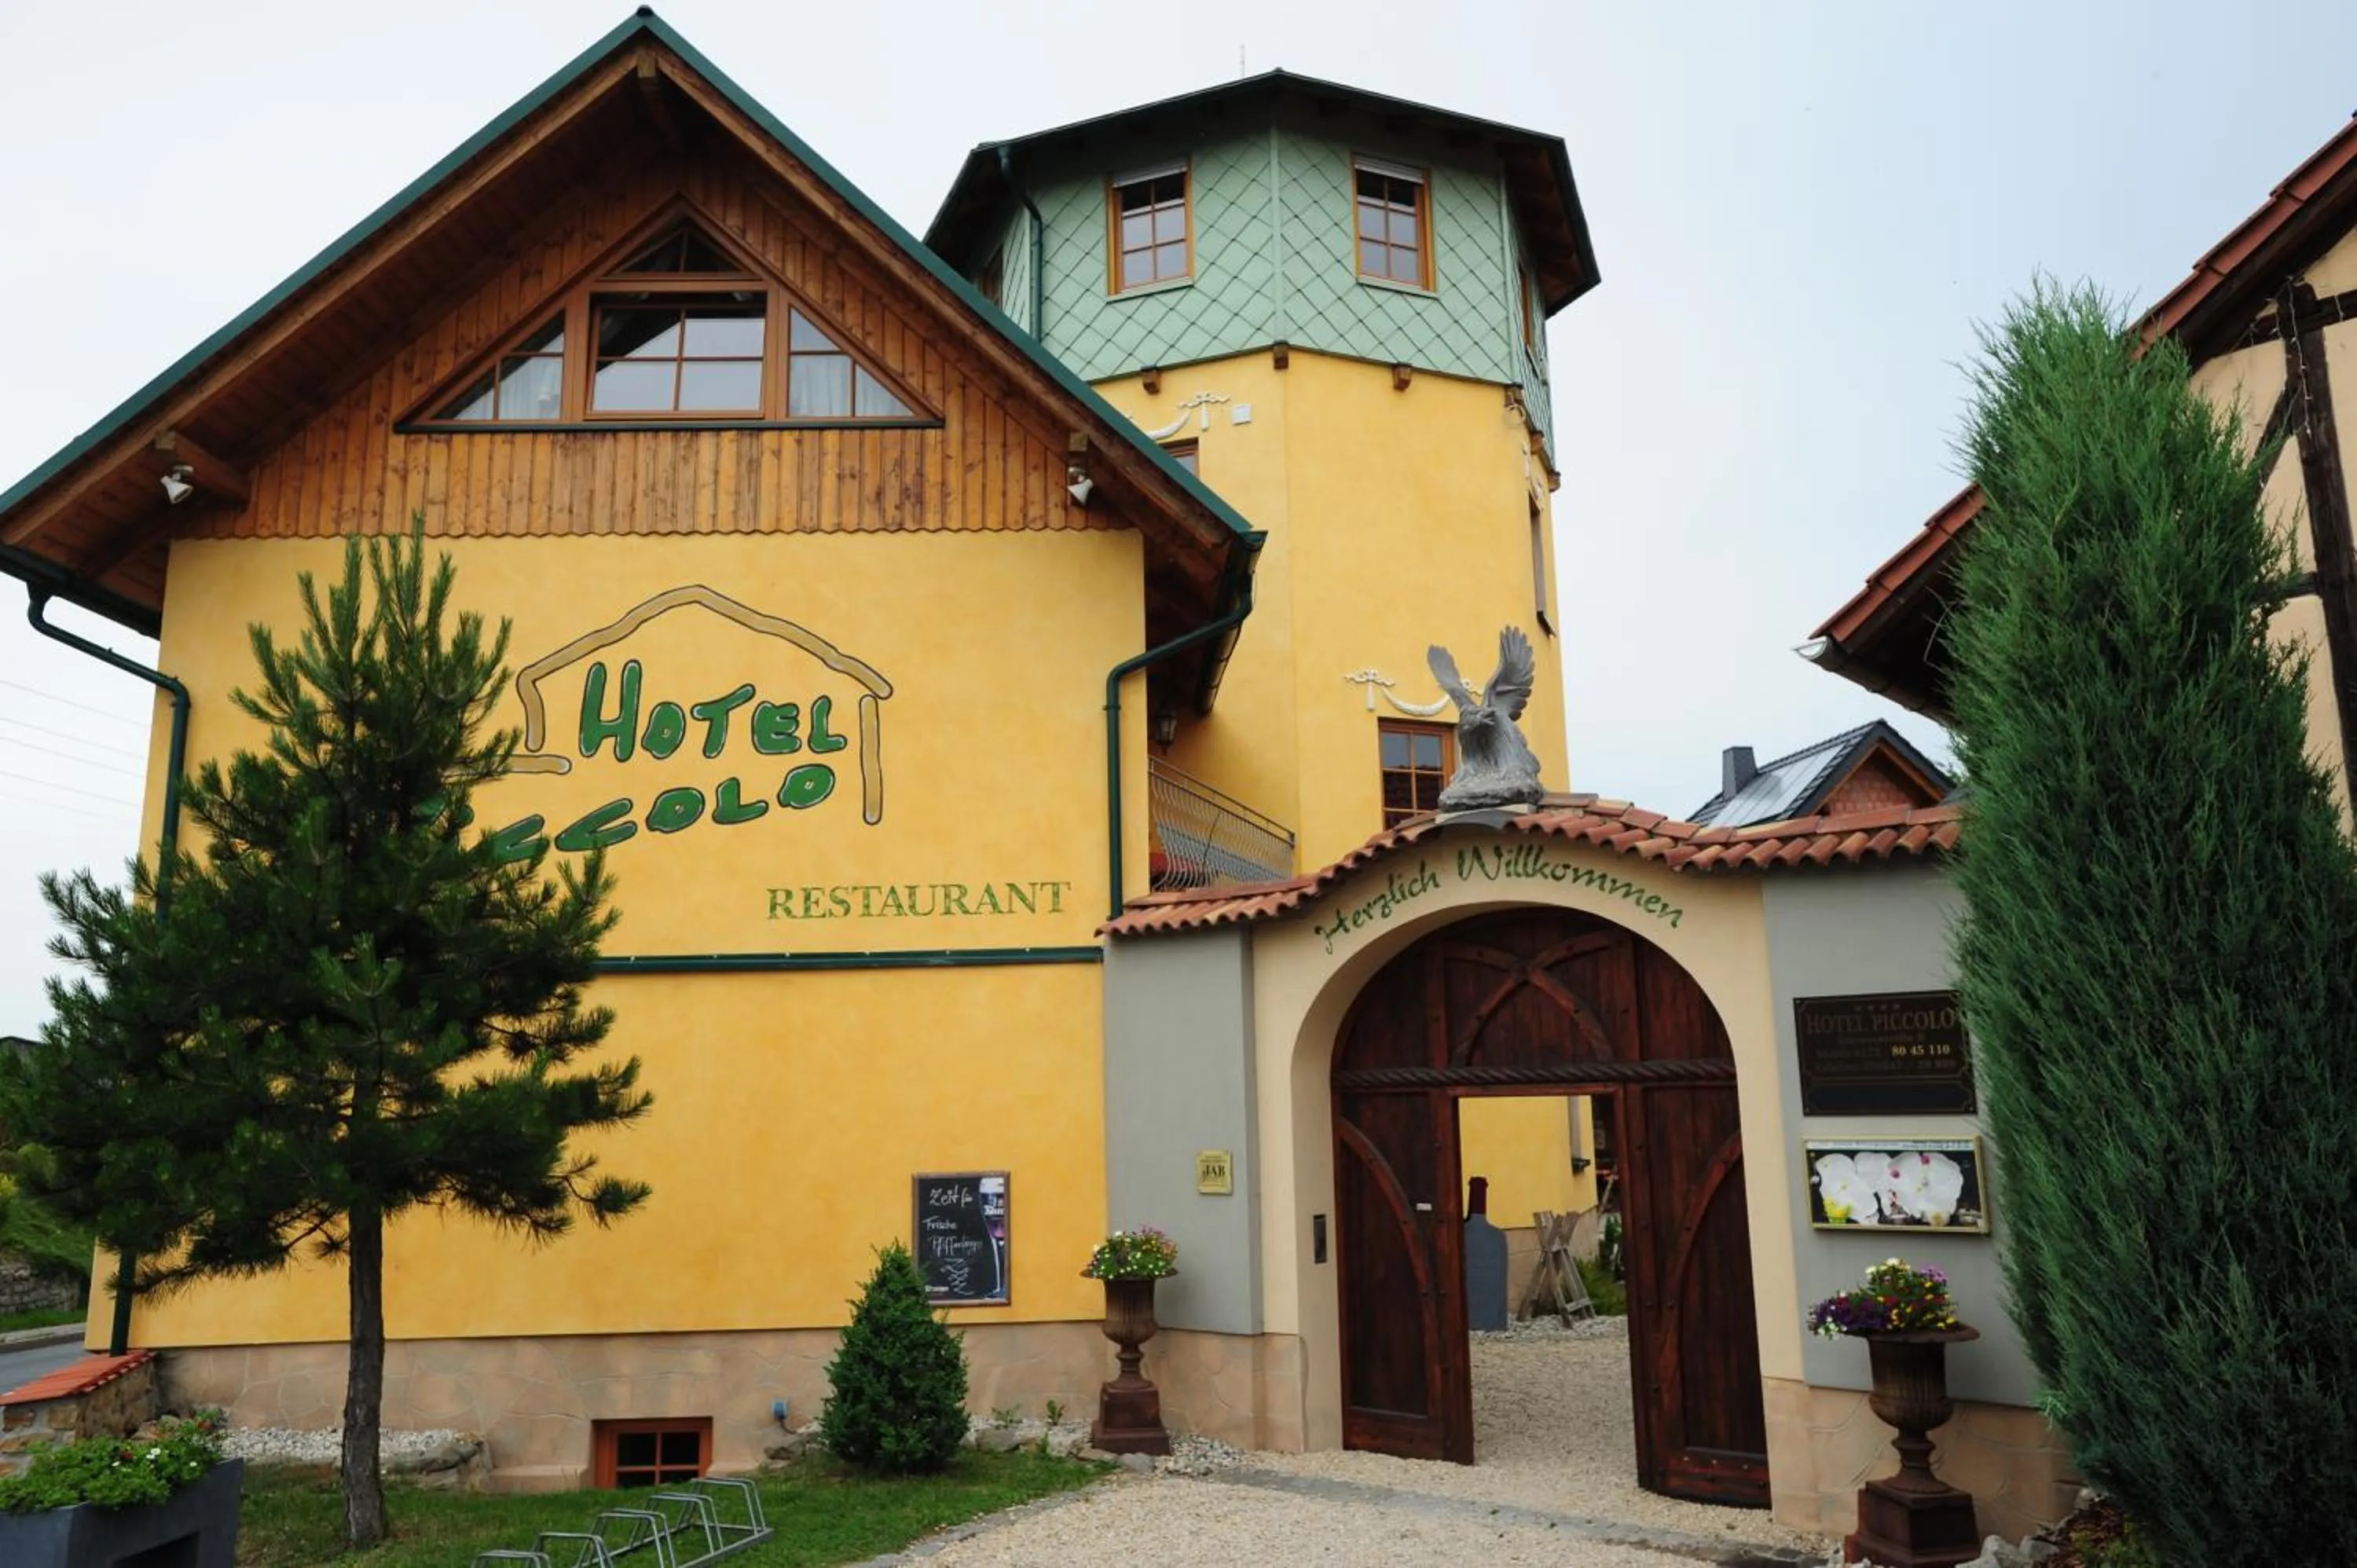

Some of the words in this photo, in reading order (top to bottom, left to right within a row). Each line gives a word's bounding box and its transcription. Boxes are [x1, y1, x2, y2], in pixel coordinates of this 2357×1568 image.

[579, 659, 848, 763] HOTEL
[766, 881, 1072, 921] RESTAURANT
[1314, 859, 1441, 955] Herzlich
[1457, 844, 1684, 929] Willkommen
[1871, 1008, 1956, 1032] PICCOLO
[1892, 1045, 1907, 1056] 80
